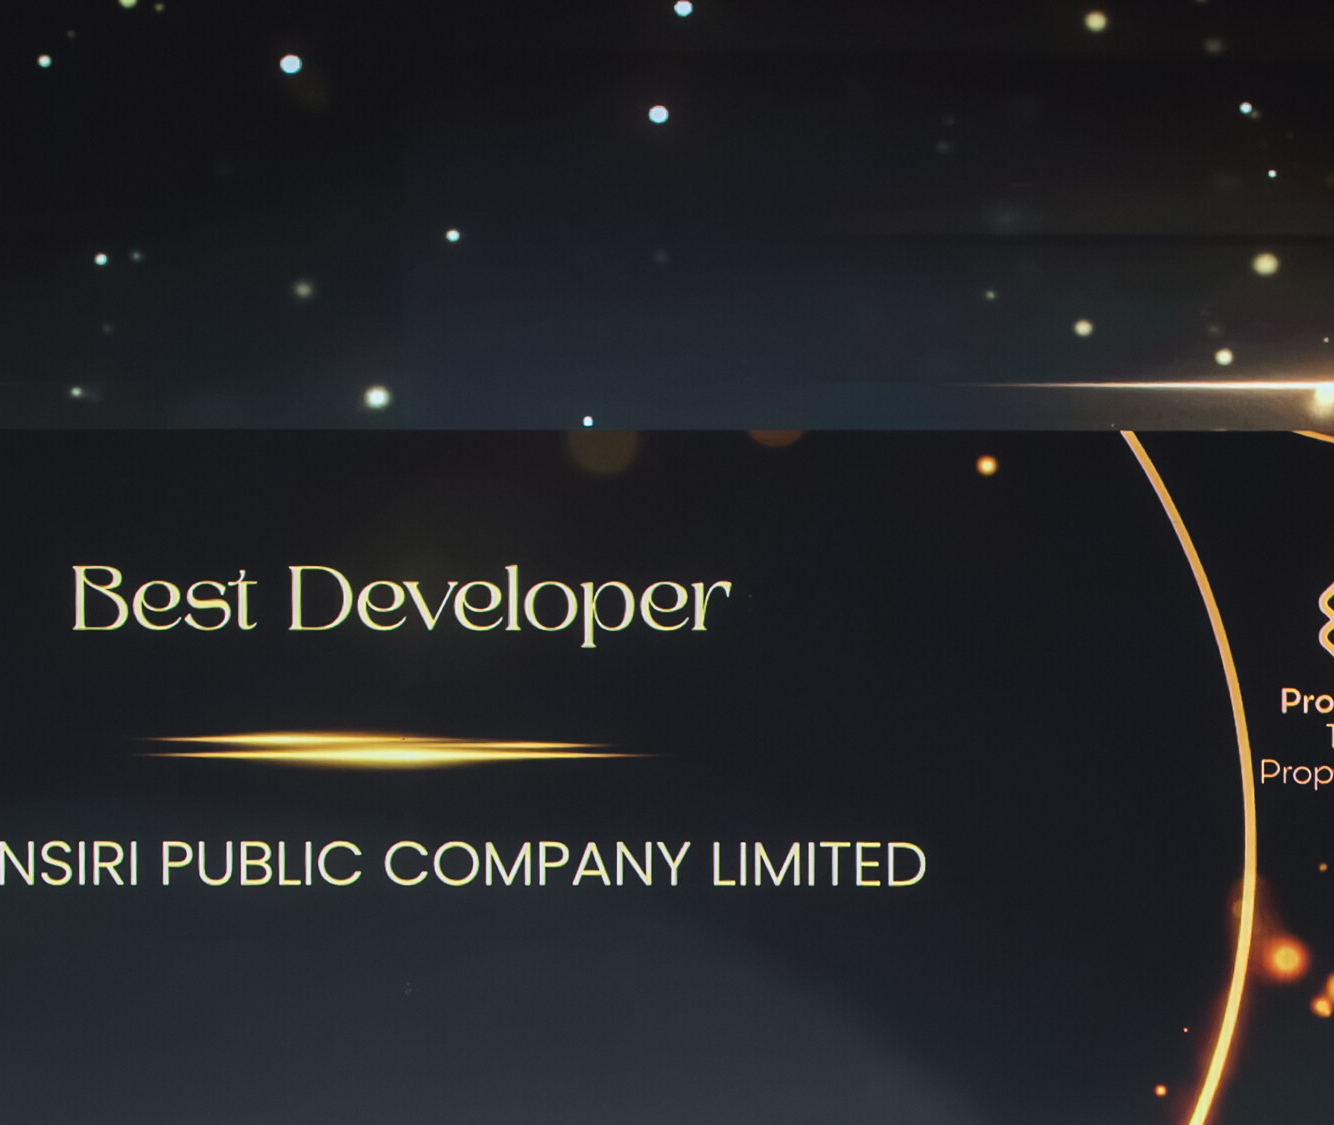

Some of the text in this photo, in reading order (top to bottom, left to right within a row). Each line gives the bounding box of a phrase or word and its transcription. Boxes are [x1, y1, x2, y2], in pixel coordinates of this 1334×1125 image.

[72, 564, 732, 649] Best Developer
[162, 840, 363, 886] PUBLIC
[384, 840, 691, 887] COMPANY
[713, 841, 927, 887] LIMITED
